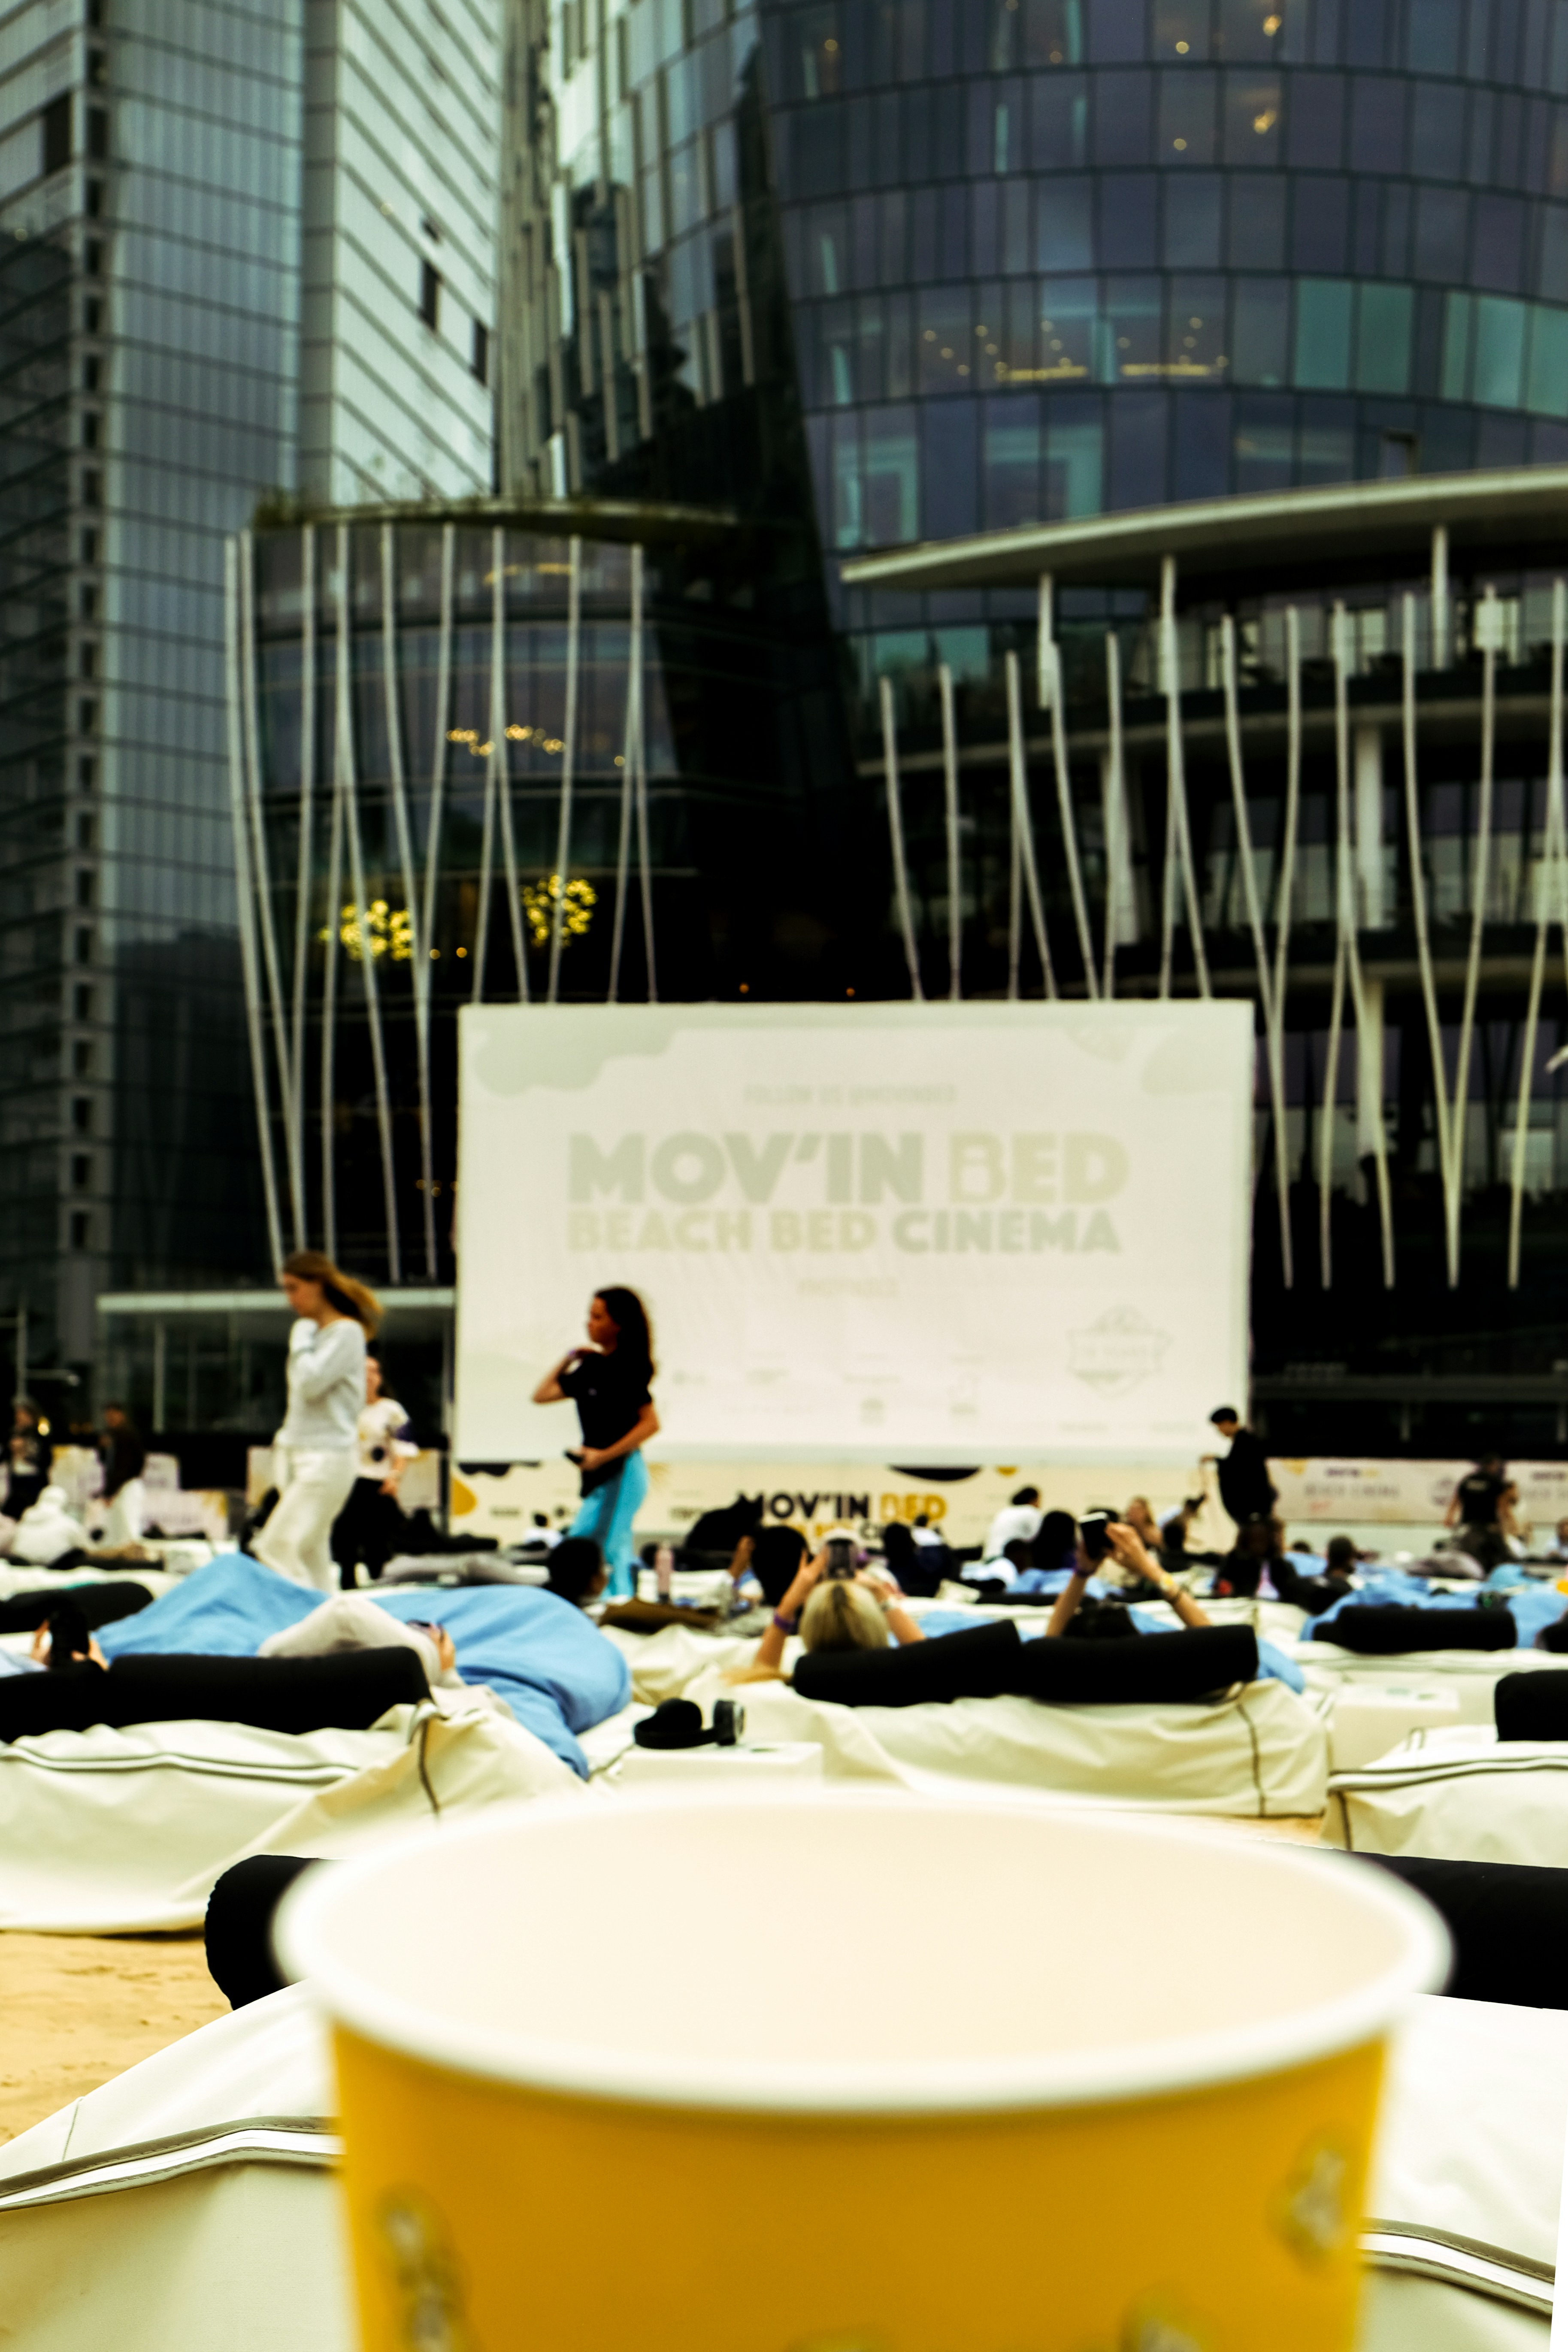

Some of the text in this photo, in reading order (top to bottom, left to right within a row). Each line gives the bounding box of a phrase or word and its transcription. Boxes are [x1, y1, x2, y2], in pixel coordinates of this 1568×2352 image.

[949, 1131, 1130, 1204] BED
[567, 1209, 1122, 1253] BEACH BED CINEMA
